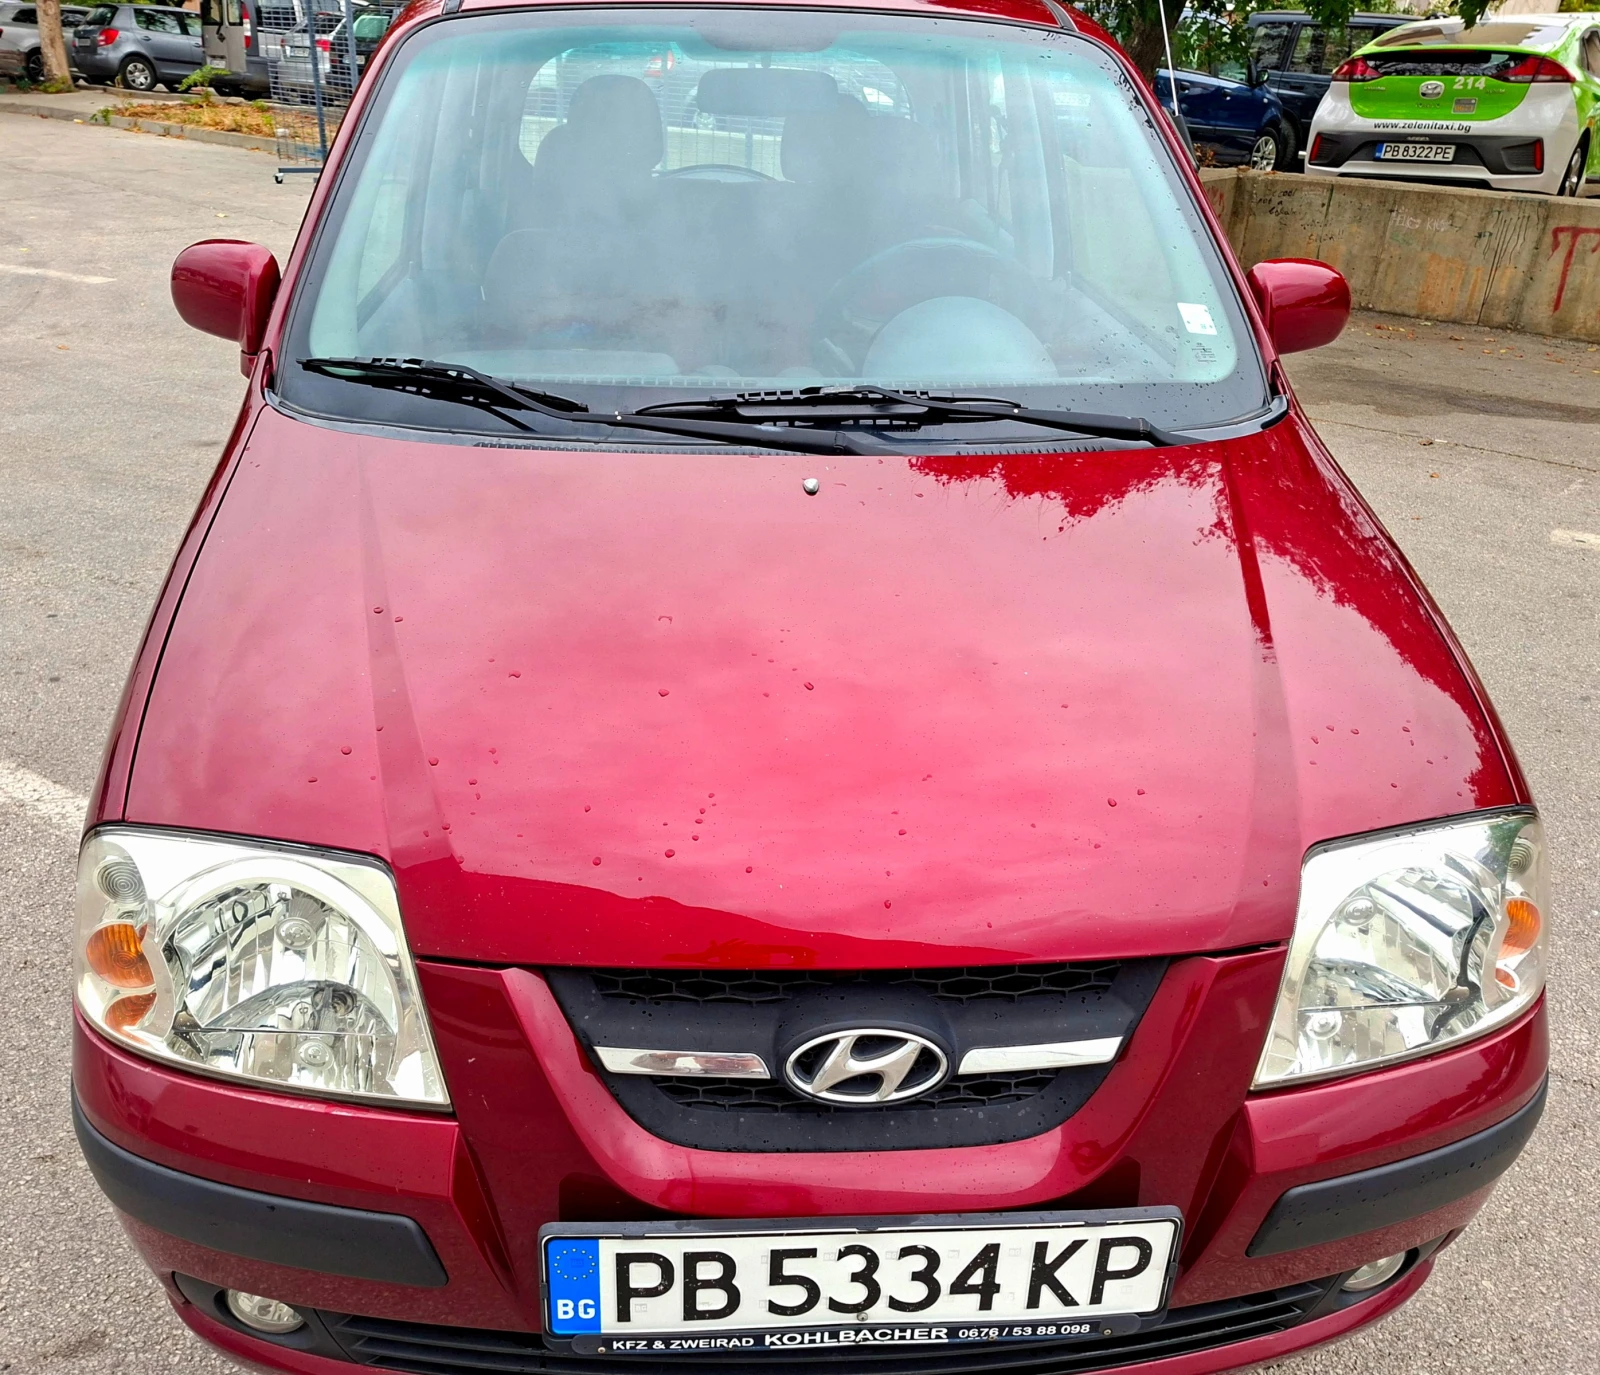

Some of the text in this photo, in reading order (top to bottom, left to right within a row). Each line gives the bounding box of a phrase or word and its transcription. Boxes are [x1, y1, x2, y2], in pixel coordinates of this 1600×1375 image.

[1453, 76, 1486, 90] 214
[1373, 121, 1472, 133] www.zelenitaxi.bg
[1383, 145, 1452, 160] PB 8322 PE
[616, 1236, 1153, 1322] PB 5334 KP
[557, 1299, 596, 1320] BG
[612, 1340, 648, 1350] KFZ
[652, 1340, 666, 1350] &
[669, 1337, 755, 1349] ZWEIRAD
[764, 1327, 948, 1346] KOHLBACHER
[958, 1327, 999, 1338] 0676
[1012, 1326, 1033, 1336] 53
[1036, 1325, 1057, 1335] 88
[1060, 1324, 1091, 1335] 098
